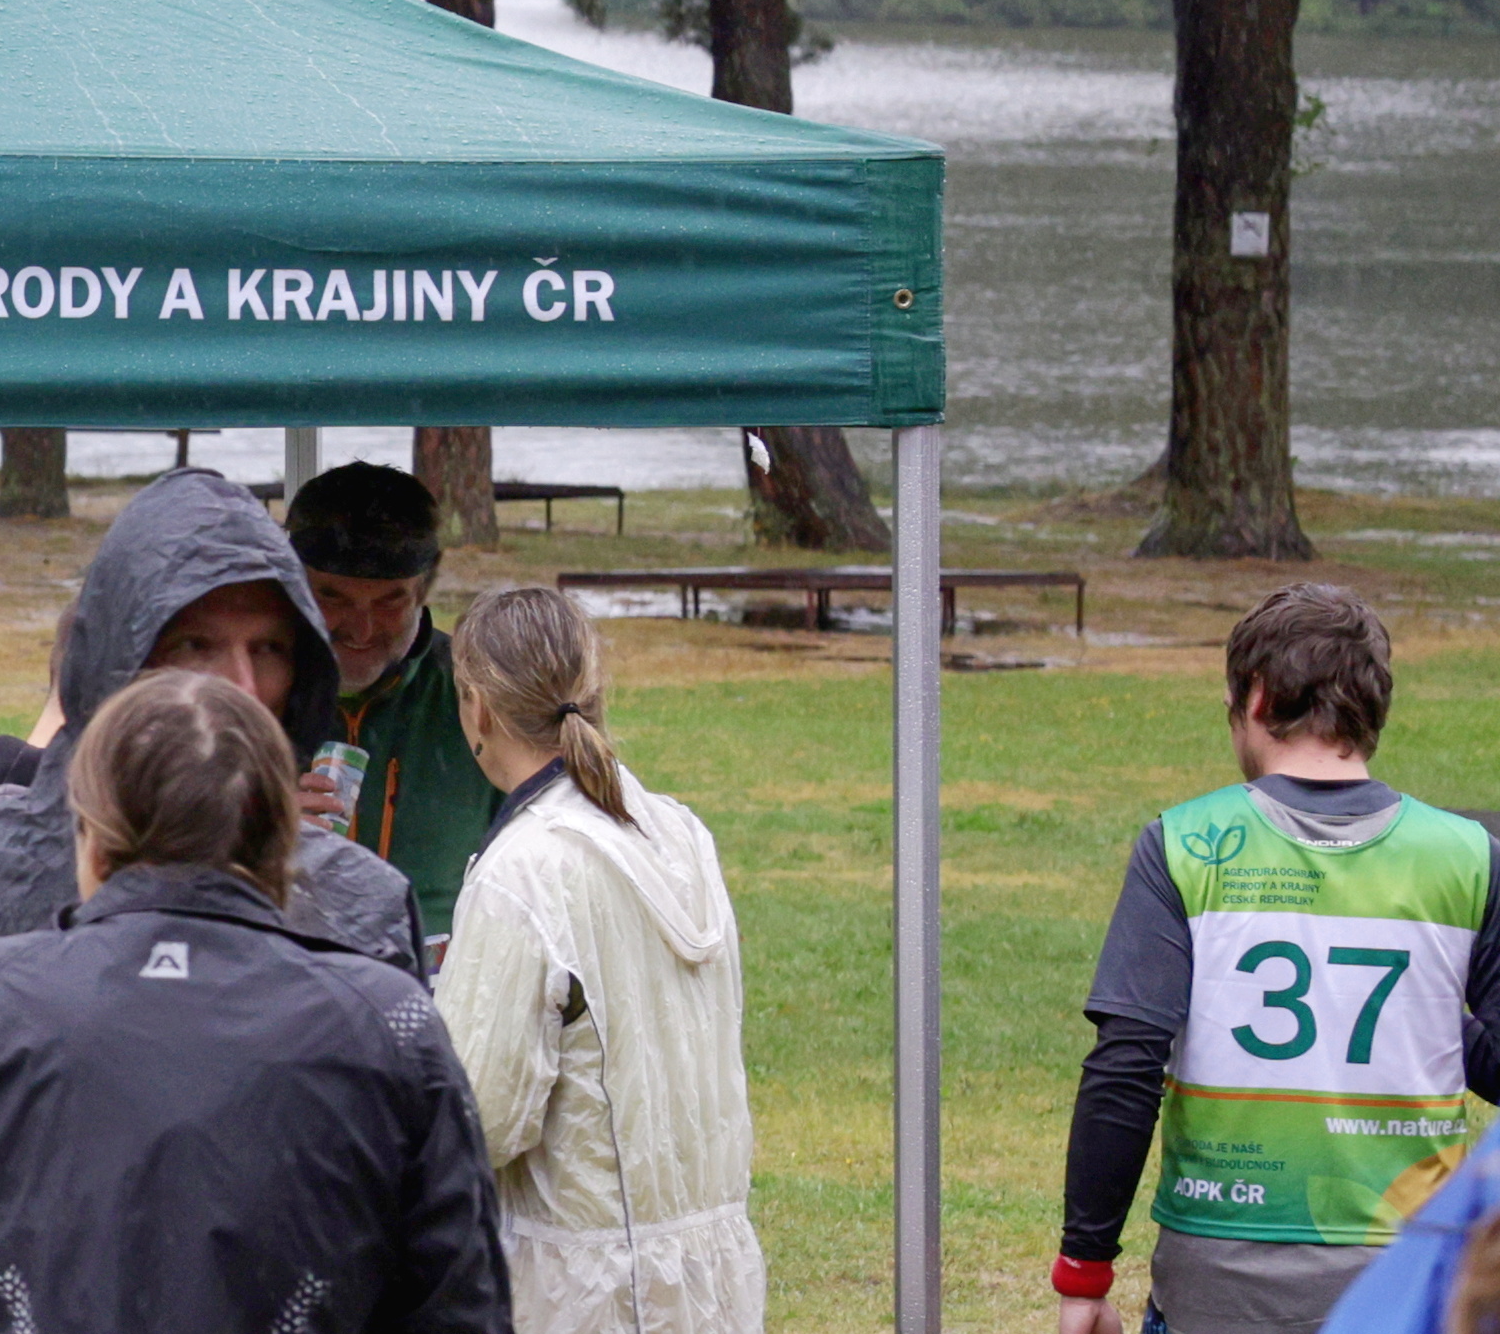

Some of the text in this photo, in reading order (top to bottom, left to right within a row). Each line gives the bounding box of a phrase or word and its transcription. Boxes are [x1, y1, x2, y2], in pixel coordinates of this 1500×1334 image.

[159, 267, 204, 320] A
[227, 268, 498, 321] KRAJINY
[522, 257, 616, 321] ČR
[1222, 868, 1327, 880] AGENTURA OCHRANY
[1269, 881, 1278, 890] A
[1280, 881, 1321, 894] KRAJINY
[1259, 894, 1315, 907] REPUBLIKY
[1231, 940, 1411, 1065] 37
[1216, 1142, 1229, 1154] JE
[1173, 1176, 1266, 1205] AOPK ČR
